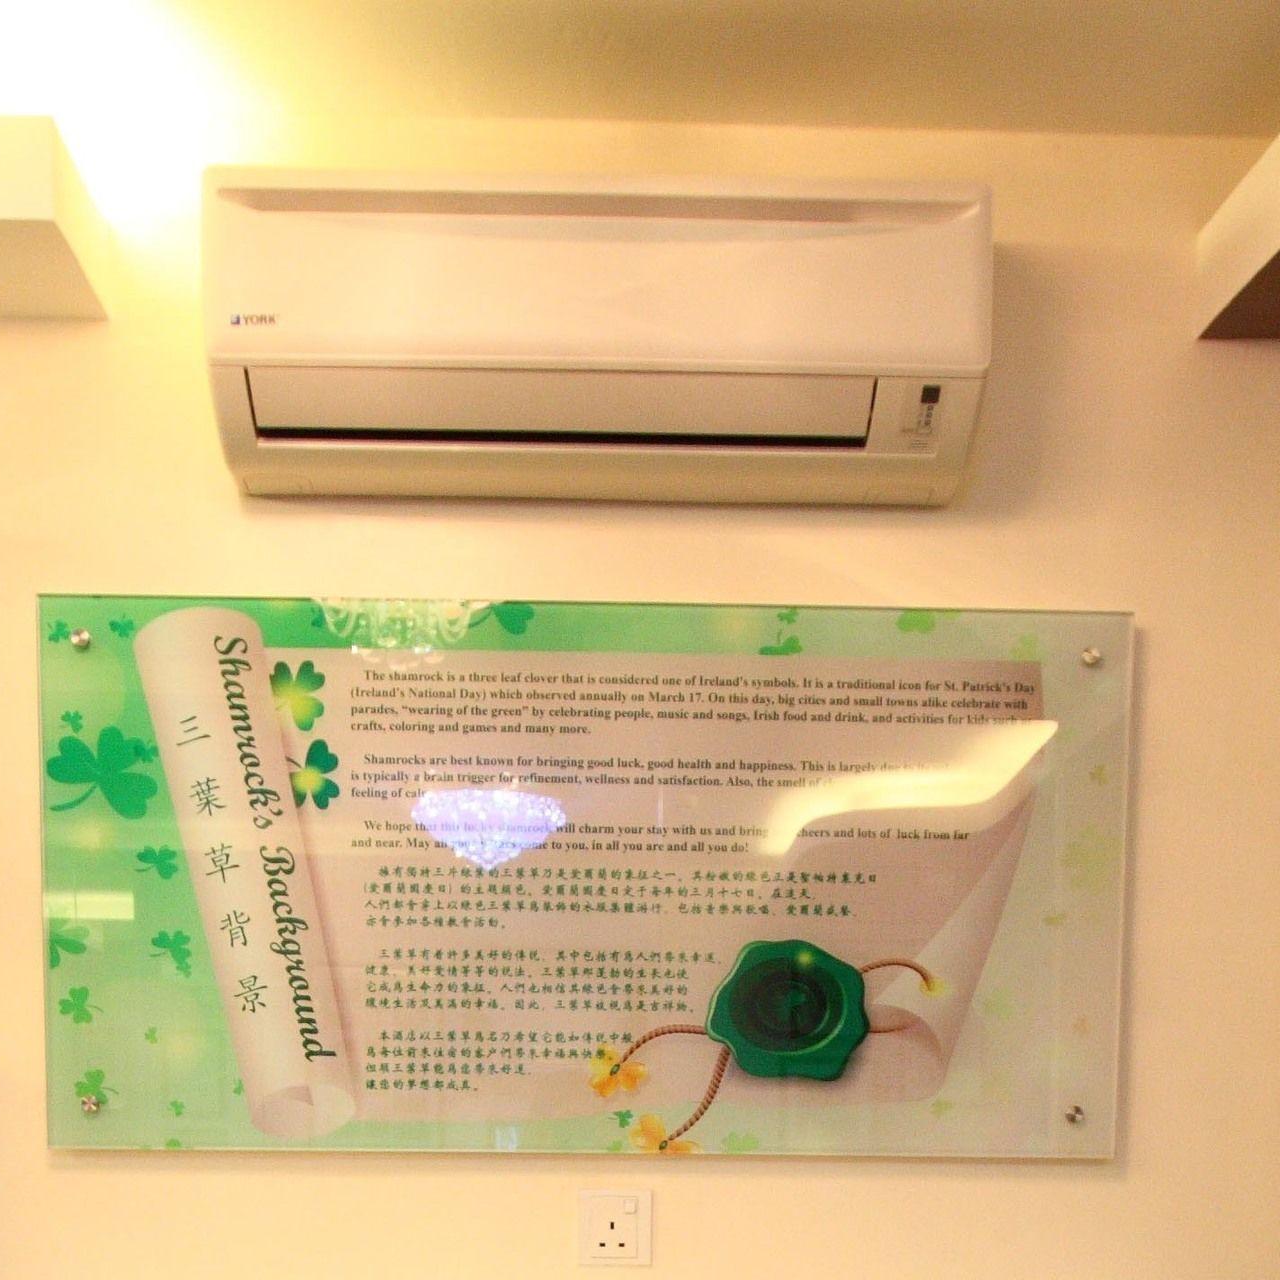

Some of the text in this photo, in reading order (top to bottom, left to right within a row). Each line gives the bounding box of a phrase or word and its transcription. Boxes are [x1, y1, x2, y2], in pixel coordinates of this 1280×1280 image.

[243, 313, 277, 326] YORK
[366, 669, 386, 682] The
[388, 670, 444, 683] shamrock
[446, 670, 456, 683] is
[459, 674, 466, 683] a
[468, 671, 498, 684] three
[500, 671, 522, 684] leaf
[524, 672, 558, 685] clover
[561, 672, 584, 685] that
[587, 672, 596, 685] is
[599, 673, 659, 686] considered
[662, 677, 682, 687] one
[684, 674, 697, 687] of
[802, 676, 813, 689] It
[814, 676, 824, 689] is
[827, 680, 834, 689] a
[836, 677, 896, 690] traditional
[898, 678, 922, 691] icon
[923, 678, 942, 691] for
[1013, 680, 1037, 695] Day
[408, 687, 457, 700] National
[489, 688, 523, 701] which
[526, 688, 576, 701] observed
[579, 689, 627, 704] annually
[631, 693, 645, 703] on
[648, 690, 686, 703] March
[707, 691, 726, 704] On
[728, 691, 749, 704] this
[776, 692, 795, 707] big
[798, 693, 827, 706] cities
[829, 693, 851, 706] and
[853, 694, 883, 707] small
[885, 695, 919, 708] towns
[921, 695, 948, 708] alike
[950, 696, 1003, 709] celebrate
[1002, 697, 1028, 710] with
[456, 704, 468, 717] of
[470, 704, 488, 717] the
[531, 705, 546, 720] by
[547, 705, 611, 720] celebrating
[656, 707, 690, 720] music
[692, 707, 714, 720] and
[753, 708, 780, 721] Irish
[783, 709, 808, 722] food
[810, 709, 832, 722] and
[871, 710, 893, 723] and
[895, 711, 944, 724] activities
[947, 712, 966, 725] for
[388, 720, 435, 734] coloring
[437, 720, 459, 733] and
[462, 724, 498, 735] games
[500, 721, 522, 734] and
[525, 725, 556, 736] many
[364, 753, 427, 766] Shamrocks
[428, 757, 447, 766] are
[449, 753, 473, 766] best
[475, 754, 514, 767] known
[516, 754, 534, 767] for
[536, 755, 584, 770] bringing
[587, 755, 614, 770] good
[647, 756, 674, 771] good
[677, 757, 712, 770] health
[714, 757, 736, 770] and
[800, 759, 825, 772] This
[826, 759, 837, 772] is
[838, 760, 879, 774] largely
[351, 770, 360, 783] is
[362, 770, 411, 785] typically
[423, 770, 454, 783] brain
[457, 771, 497, 785] trigger
[498, 771, 516, 784] for
[585, 772, 630, 785] wellness
[633, 772, 655, 785] and
[756, 774, 776, 787] the
[775, 775, 808, 788] smell
[352, 786, 427, 801] feeling of cal
[364, 819, 382, 832] We
[385, 819, 413, 834] hope
[553, 821, 576, 834] will
[578, 822, 615, 835] charm
[617, 826, 645, 837] your
[646, 823, 671, 838] stay
[670, 823, 697, 836] with
[699, 827, 713, 837] us
[714, 824, 736, 837] and
[833, 826, 855, 839] and
[857, 827, 878, 840] lots
[879, 827, 892, 840] of
[895, 827, 921, 840] luck
[923, 827, 951, 840] from
[952, 828, 971, 841] far
[213, 635, 337, 1062] Shamrock's Background
[352, 836, 372, 849] and
[406, 837, 433, 851] May
[549, 838, 563, 851] to
[591, 838, 603, 851] in
[606, 838, 620, 851] all
[622, 842, 643, 853] you
[646, 842, 664, 852] are
[666, 839, 688, 852] and
[690, 839, 705, 852] all
[707, 843, 728, 854] you
[730, 839, 749, 852] do!
[175, 714, 269, 1014] 三葉草背景
